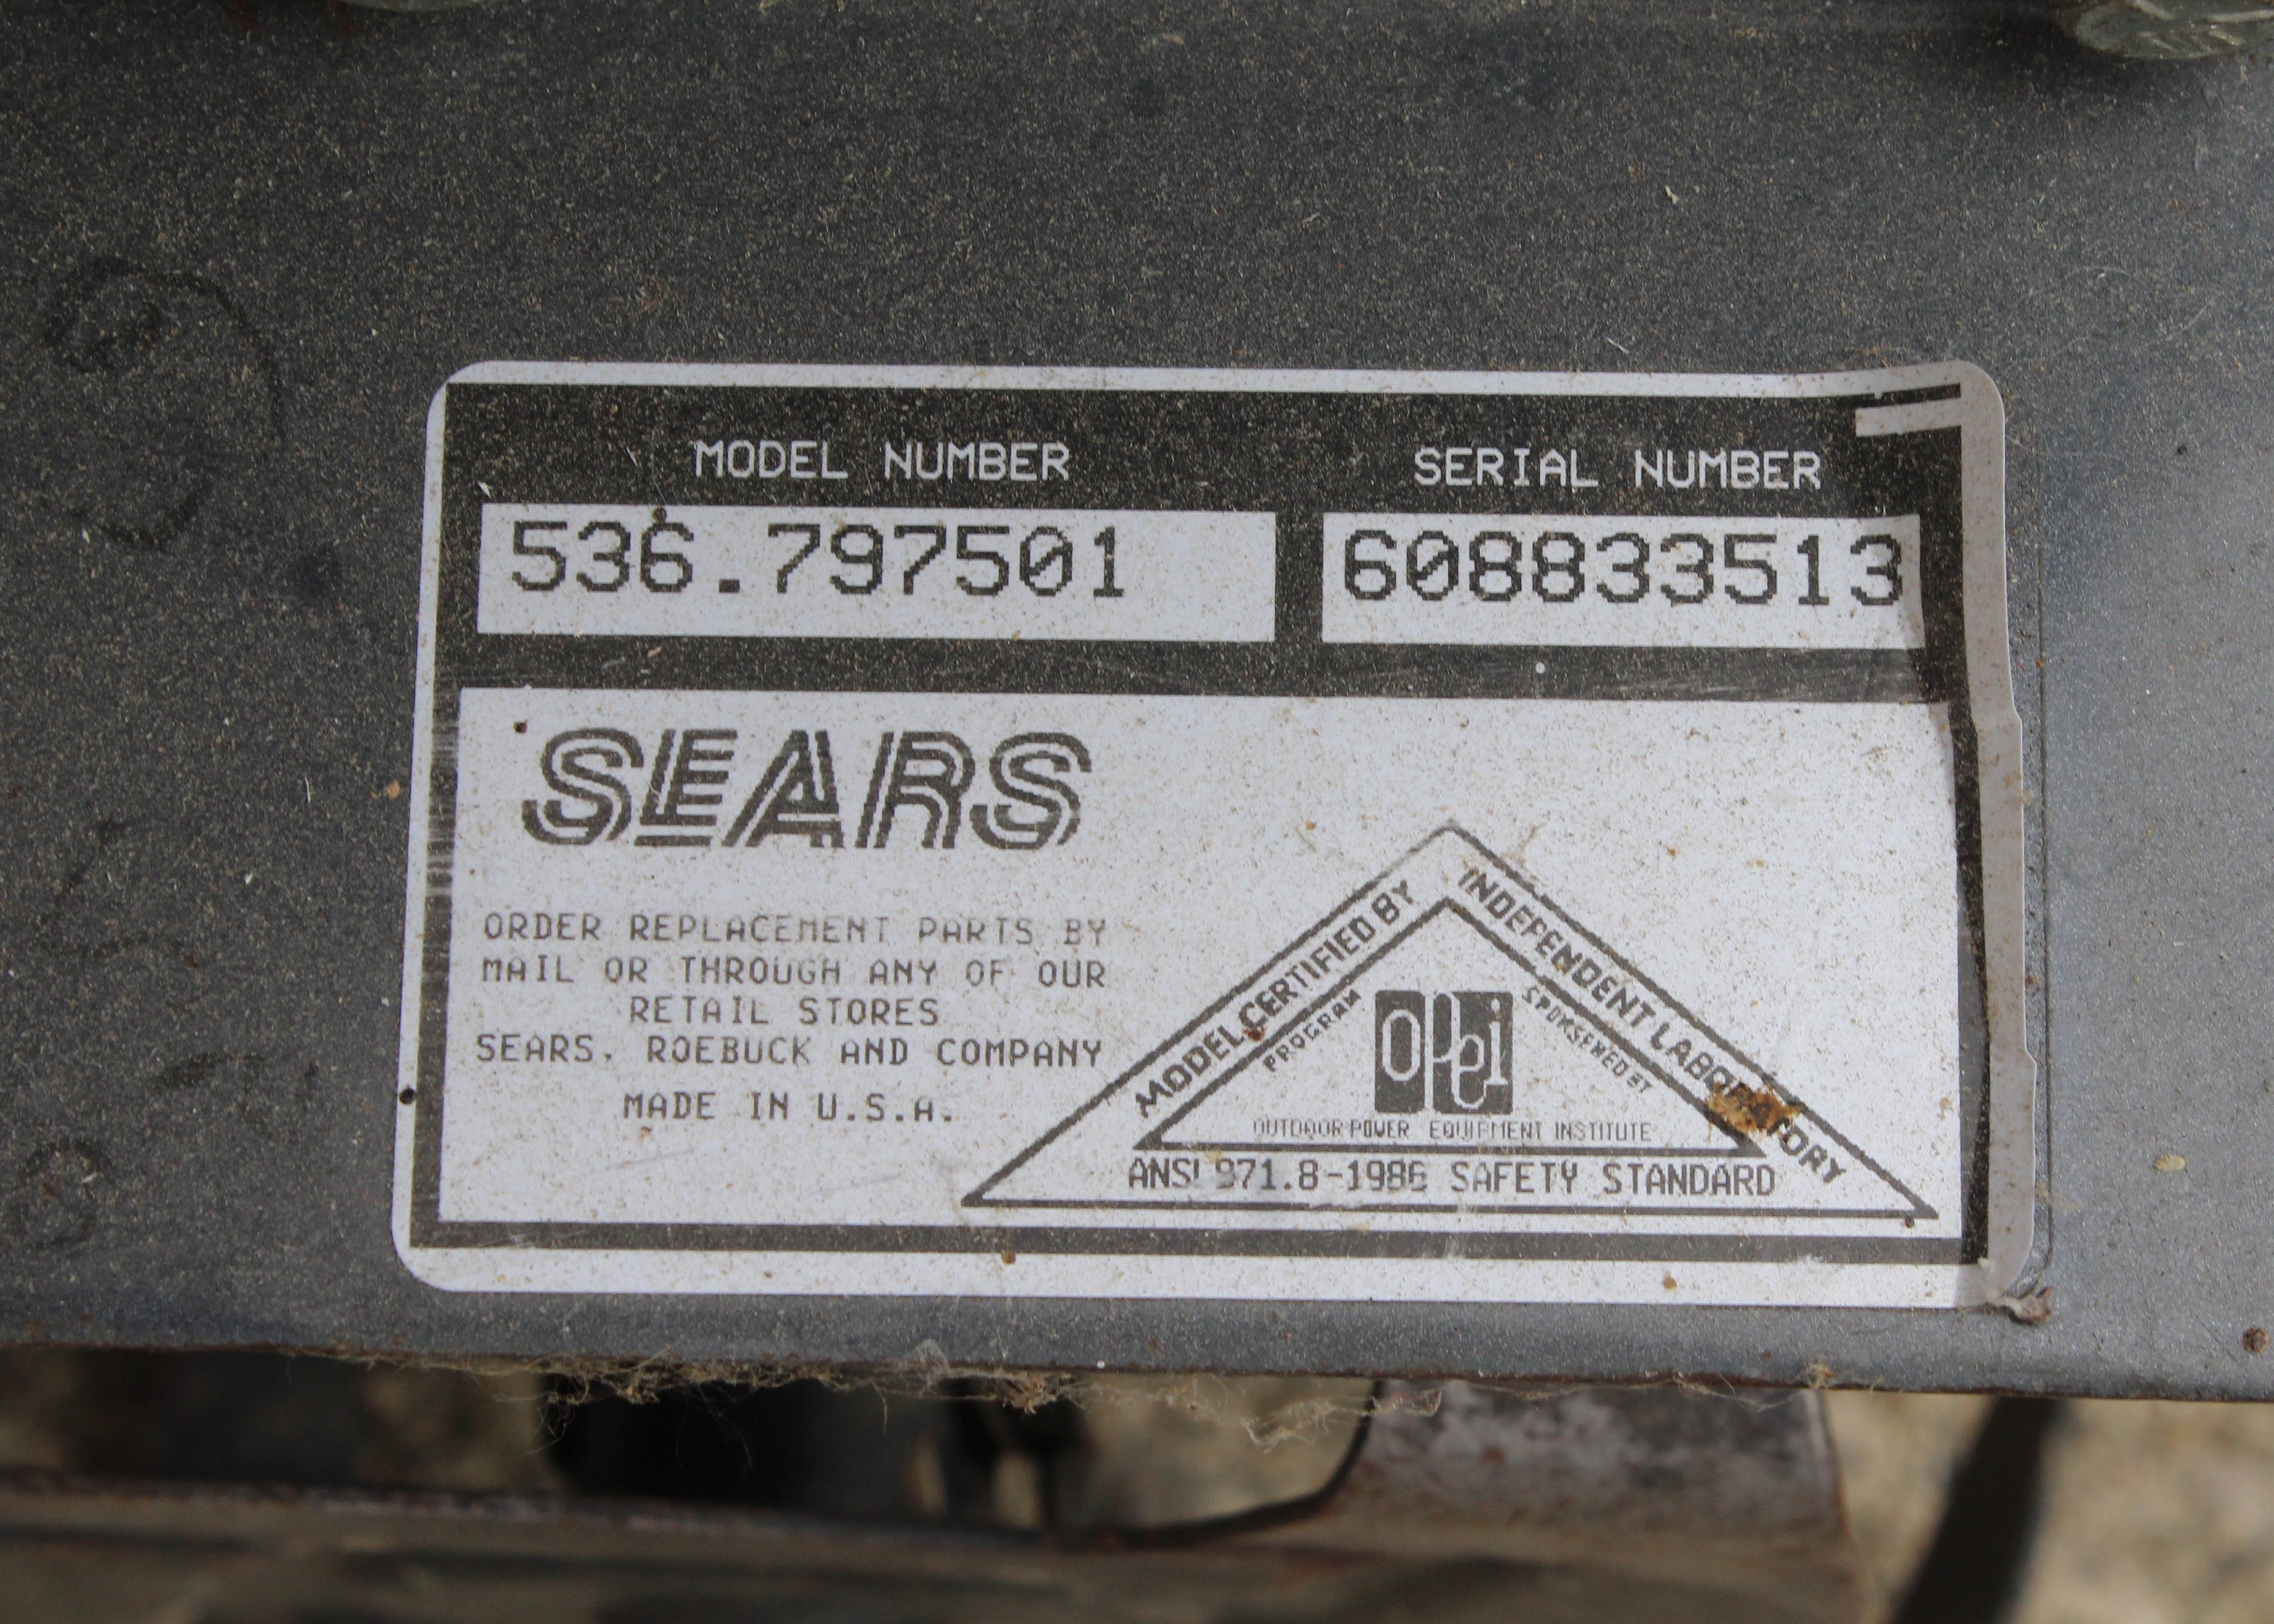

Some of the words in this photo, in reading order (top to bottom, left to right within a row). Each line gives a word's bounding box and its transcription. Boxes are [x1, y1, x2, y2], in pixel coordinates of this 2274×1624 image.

[694, 440, 848, 481] MODEL
[884, 443, 1070, 482] NUMBER
[1413, 447, 1599, 489] SERIAL
[1634, 450, 1821, 490] NUMBER
[510, 519, 1125, 598] 536.797501
[1344, 530, 1903, 607] 608833513
[521, 727, 1093, 849] SEARS
[483, 913, 601, 942] ORDER
[629, 914, 889, 944] REPLACEMENT
[918, 917, 1034, 944] PARTS
[1064, 919, 1106, 945] BY
[1458, 869, 1656, 1029] INDEPENDENT
[482, 955, 574, 983] MAIL
[604, 957, 648, 984] OR
[681, 957, 840, 985] THROUGH
[870, 959, 937, 986] ANY
[967, 960, 1006, 986] OF
[1038, 961, 1106, 988] OUR
[630, 996, 769, 1024] RETAIL
[799, 998, 939, 1026] STORES
[1135, 1025, 1245, 1118] MODEL
[1238, 915, 1377, 1031] CERTIFIED
[1371, 880, 1413, 925] BY
[646, 1034, 811, 1064] ROEBUCK
[841, 1037, 909, 1064] AND
[937, 1038, 1102, 1068] COMPANY
[1263, 989, 1361, 1072] PROGRAM
[623, 1092, 716, 1119] MADE
[751, 1093, 789, 1120] IN
[818, 1093, 952, 1122] U.S.A.
[1253, 1119, 1341, 1139] OUTDOOR
[1350, 1120, 1410, 1139] POWER
[1429, 1120, 1542, 1140] EQUIPMENT
[1555, 1121, 1652, 1142] INSTITUTE
[1451, 1161, 1578, 1194] SAFETY
[1604, 1163, 1775, 1197] STANDARD
